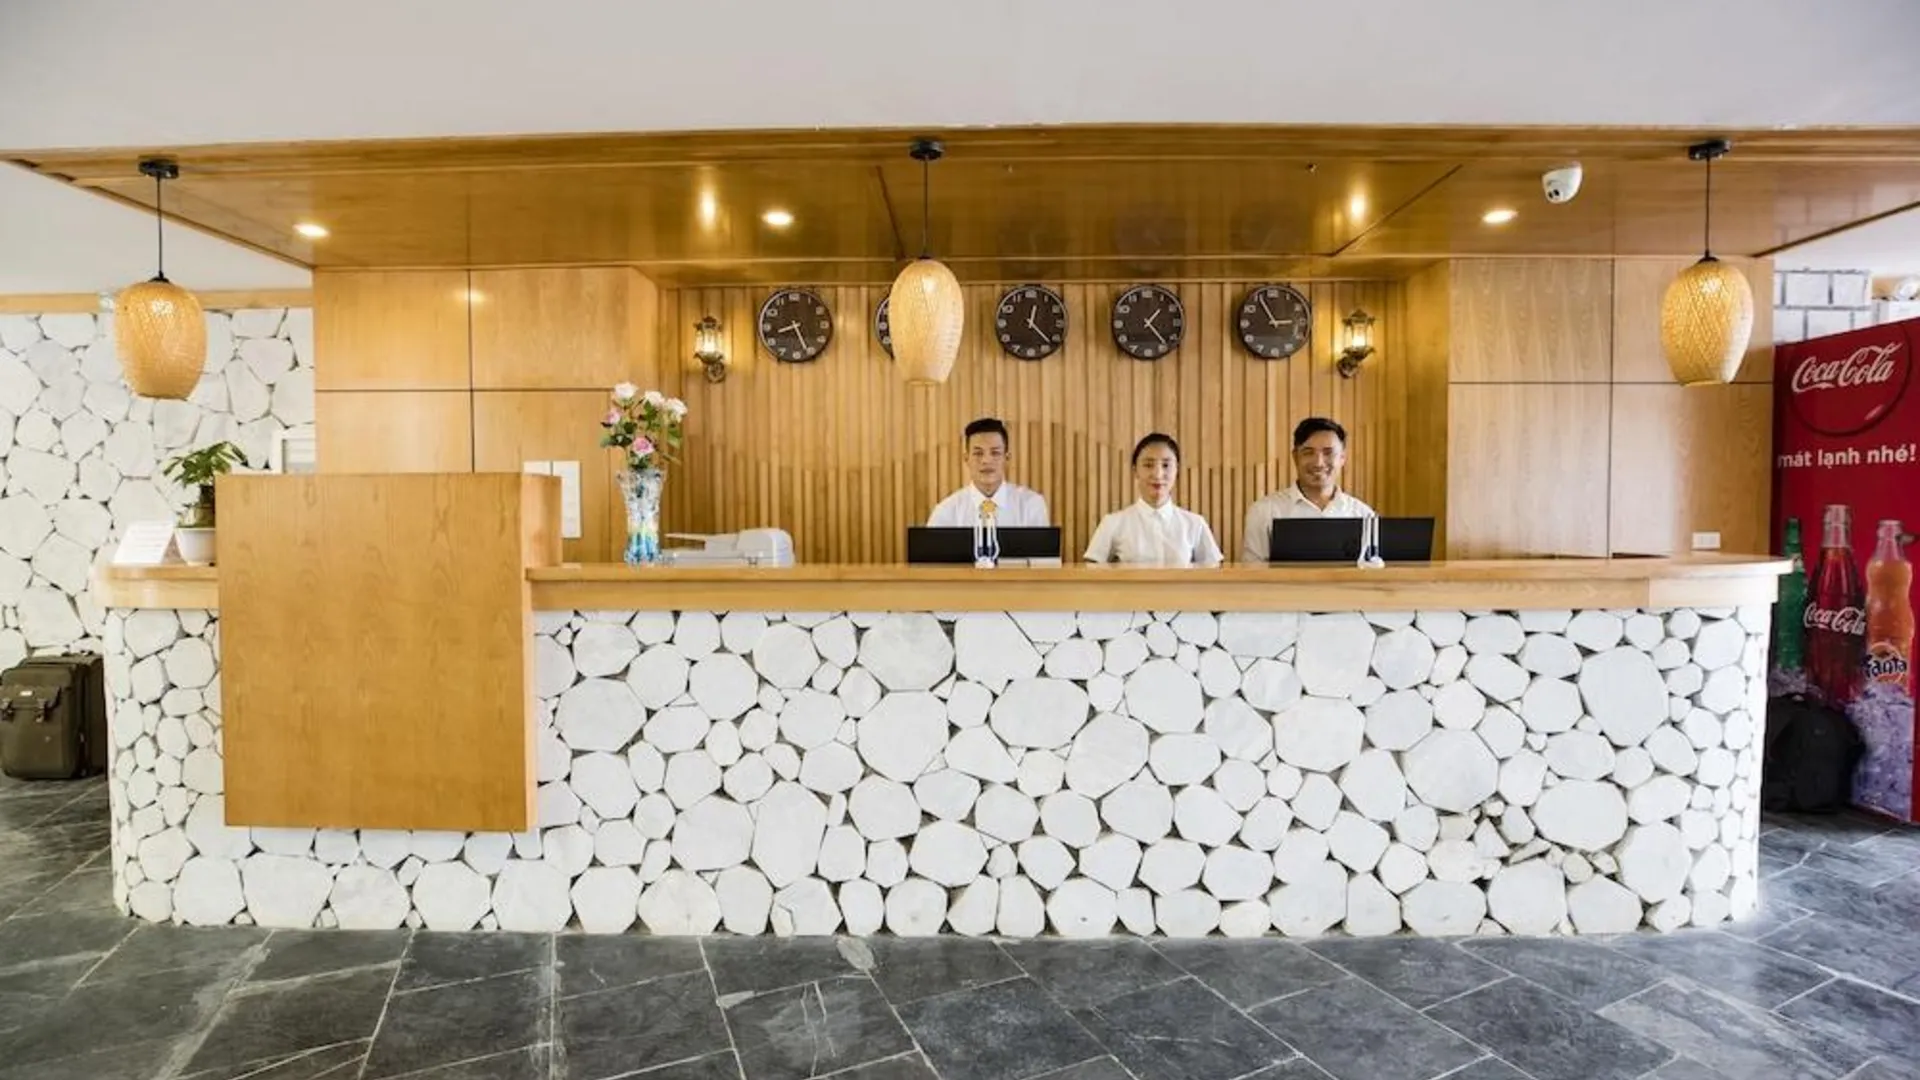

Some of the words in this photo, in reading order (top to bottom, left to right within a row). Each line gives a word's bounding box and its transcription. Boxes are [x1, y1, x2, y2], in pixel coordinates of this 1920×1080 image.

[1791, 342, 1902, 393] Coca-Cola
[1778, 451, 1812, 468] mát
[1817, 447, 1860, 469] lạnh
[1867, 443, 1916, 464] nhé!
